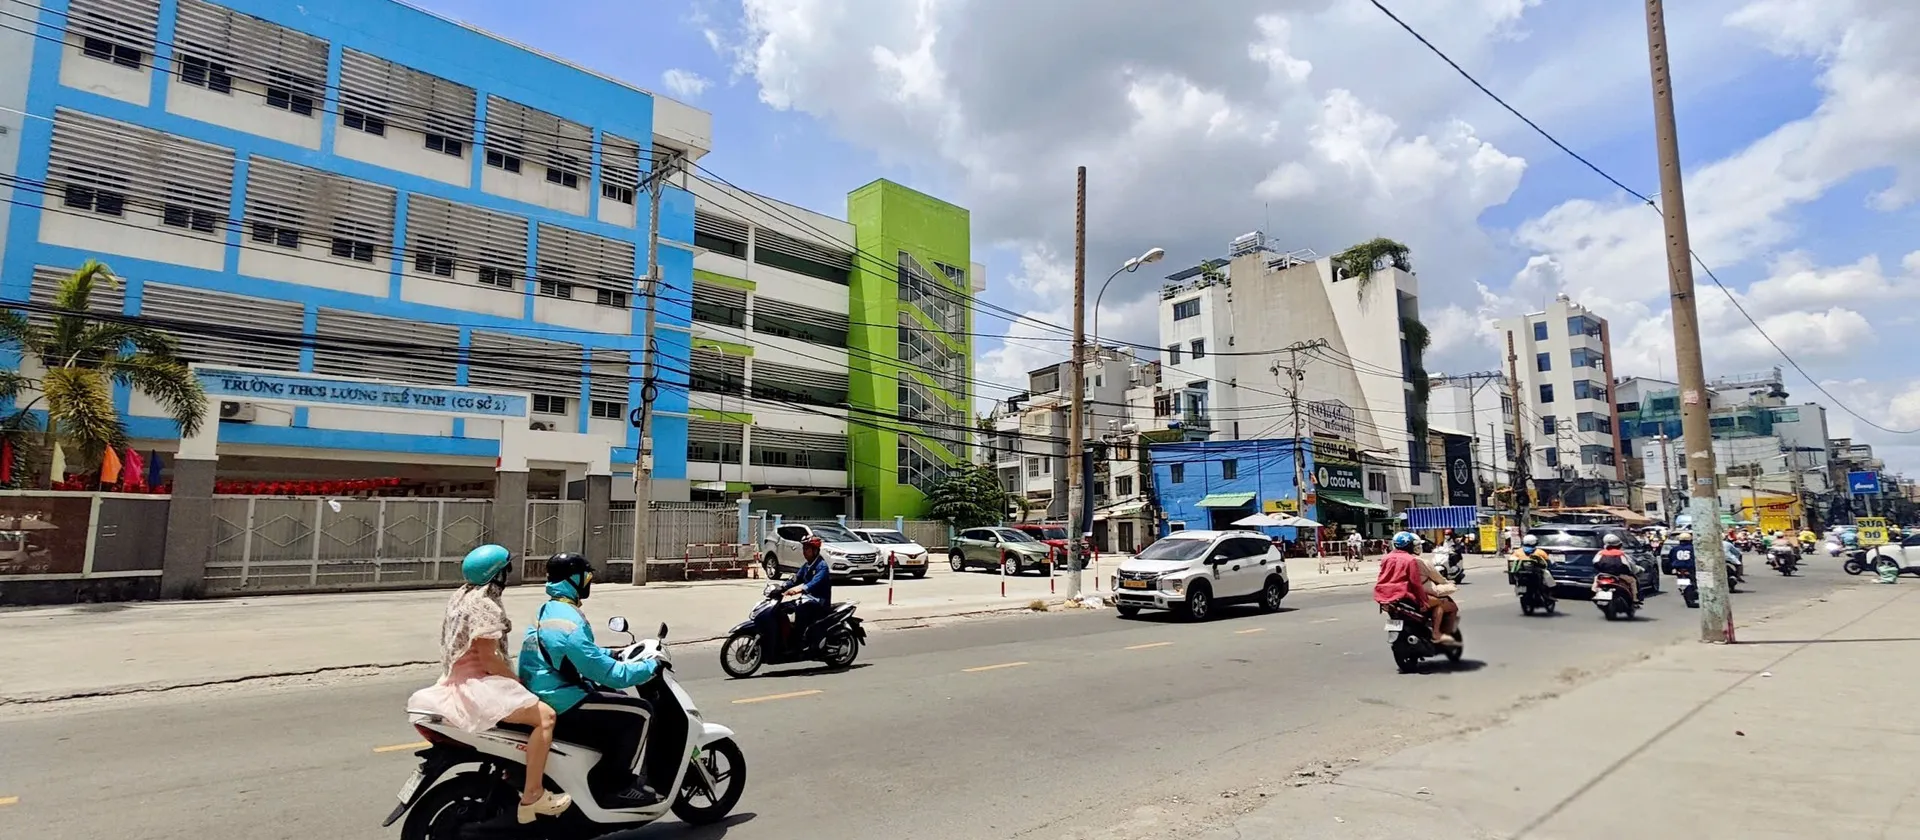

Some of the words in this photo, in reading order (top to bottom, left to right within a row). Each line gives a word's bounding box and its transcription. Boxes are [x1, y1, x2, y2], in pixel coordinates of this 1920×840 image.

[221, 376, 284, 394] TRƯỜNG
[288, 384, 326, 397] THCS
[330, 387, 378, 401] LƯƠNG
[382, 388, 410, 404] THẾ
[412, 393, 446, 407] VINH
[1330, 476, 1346, 487] COCO
[1676, 550, 1690, 560] 05
